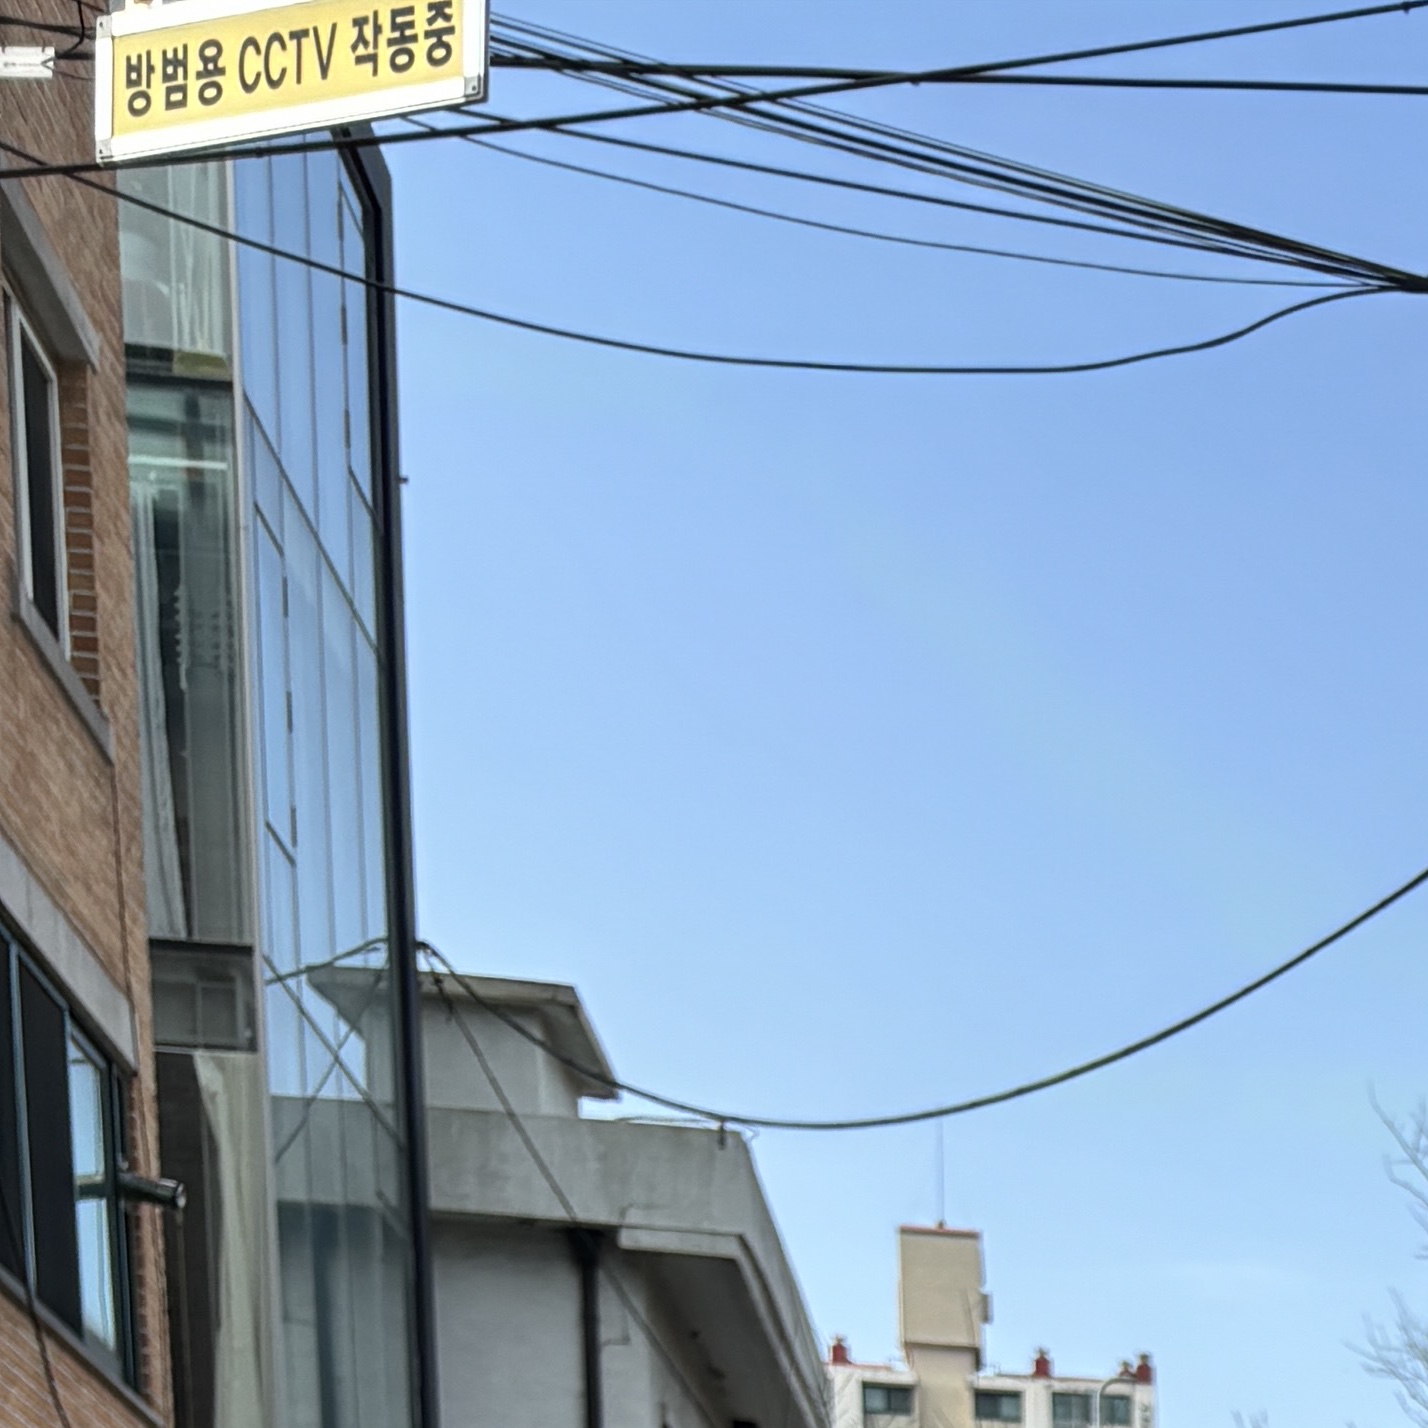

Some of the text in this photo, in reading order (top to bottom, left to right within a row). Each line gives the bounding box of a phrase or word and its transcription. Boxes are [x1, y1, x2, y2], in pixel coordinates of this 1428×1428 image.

[125, 0, 457, 118] 방범용 CCTV 작동중
